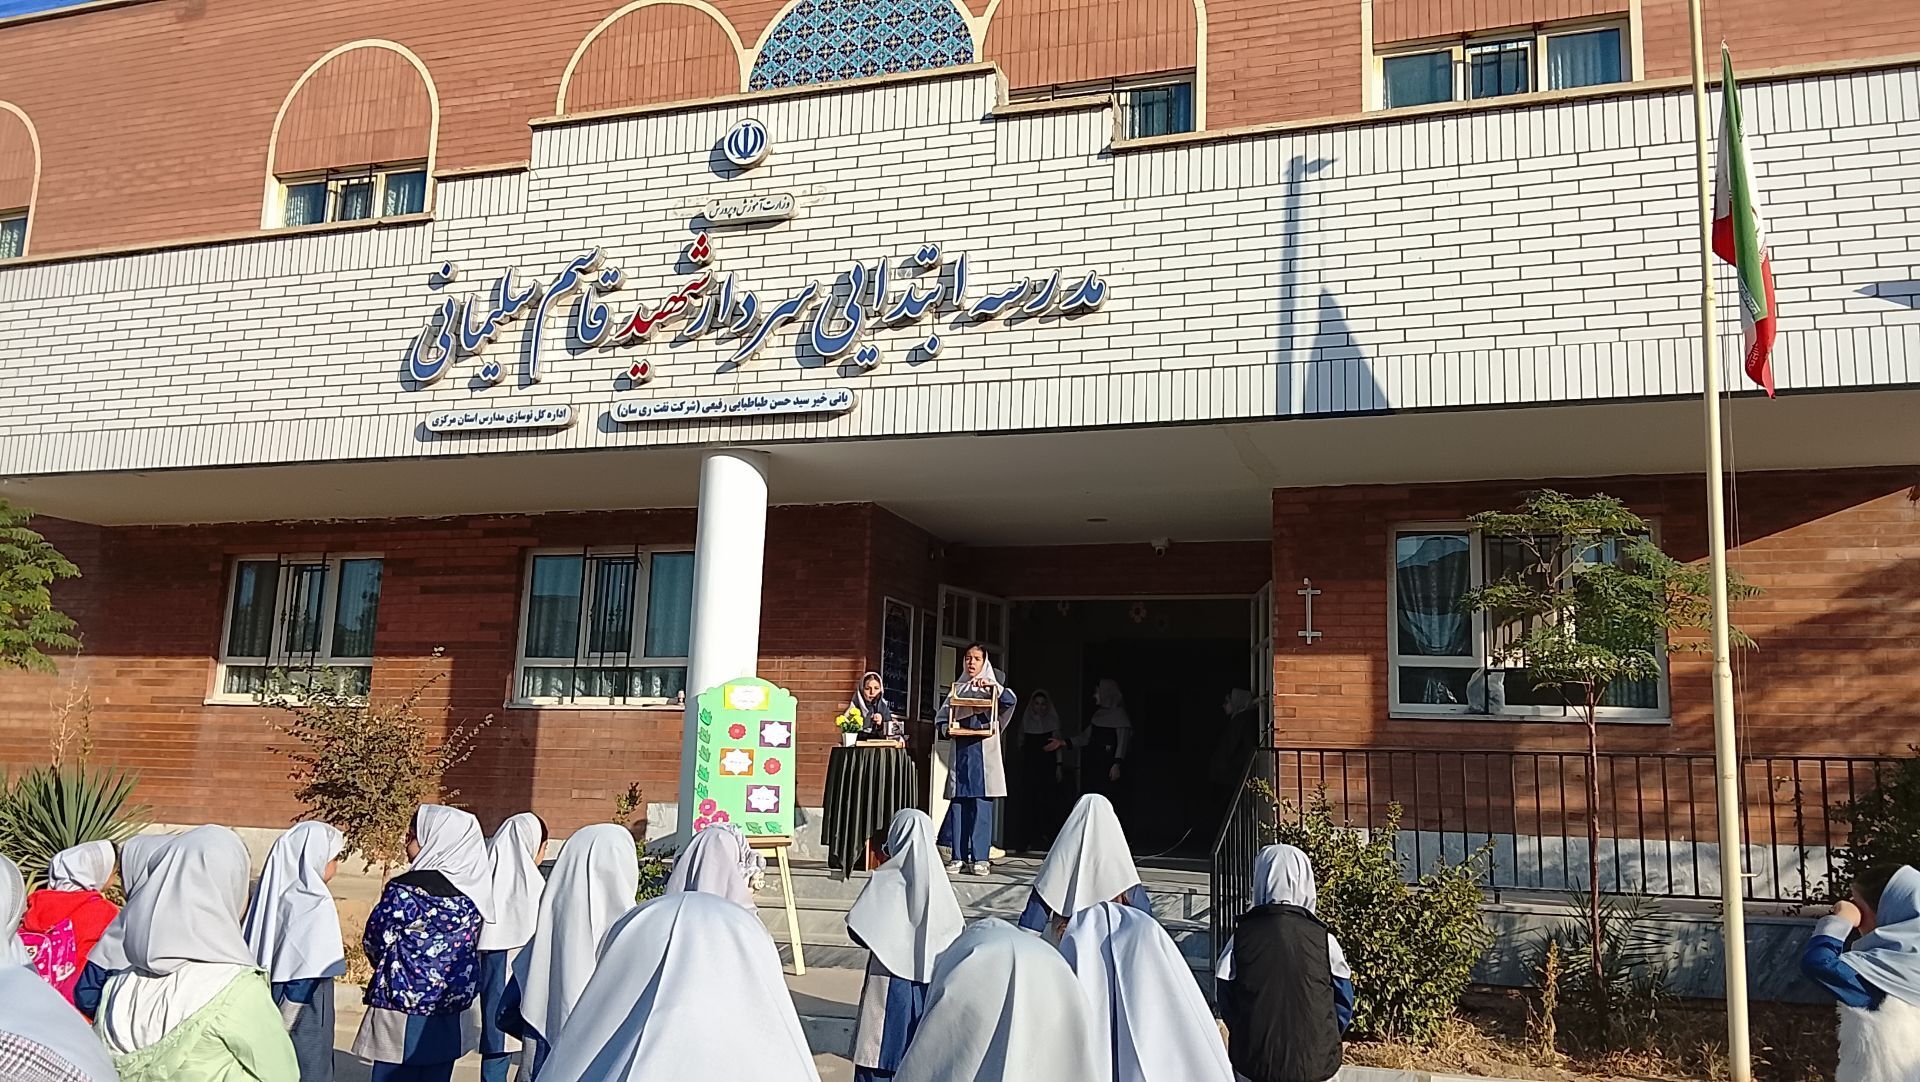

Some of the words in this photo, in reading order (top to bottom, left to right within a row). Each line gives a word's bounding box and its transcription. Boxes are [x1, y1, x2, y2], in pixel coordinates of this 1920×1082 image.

[708, 200, 734, 219] پرورش
[736, 197, 767, 216] آموزش
[763, 196, 790, 211] وزارت
[967, 268, 1107, 318] مدرسه
[529, 245, 622, 380] قاسم
[614, 231, 712, 381] شهید
[811, 243, 967, 367] ابتدایی
[409, 259, 538, 382] سلیمانی
[683, 270, 819, 363] سردار
[702, 398, 727, 413] رفیعی
[729, 396, 768, 413] طباطبایی
[769, 397, 792, 410] حسن
[793, 396, 810, 408] سید
[811, 392, 828, 408] خیر
[829, 391, 849, 408] بانی
[533, 408, 546, 421] کل
[546, 407, 567, 421] اداره
[617, 403, 638, 418] سان)
[638, 406, 652, 417] ری
[653, 402, 669, 413] نفت
[670, 400, 701, 415] (شرکت
[431, 414, 456, 427] مرکزی
[457, 412, 478, 426] استان
[478, 412, 505, 425] مدارس
[506, 409, 533, 424] نوسازی
